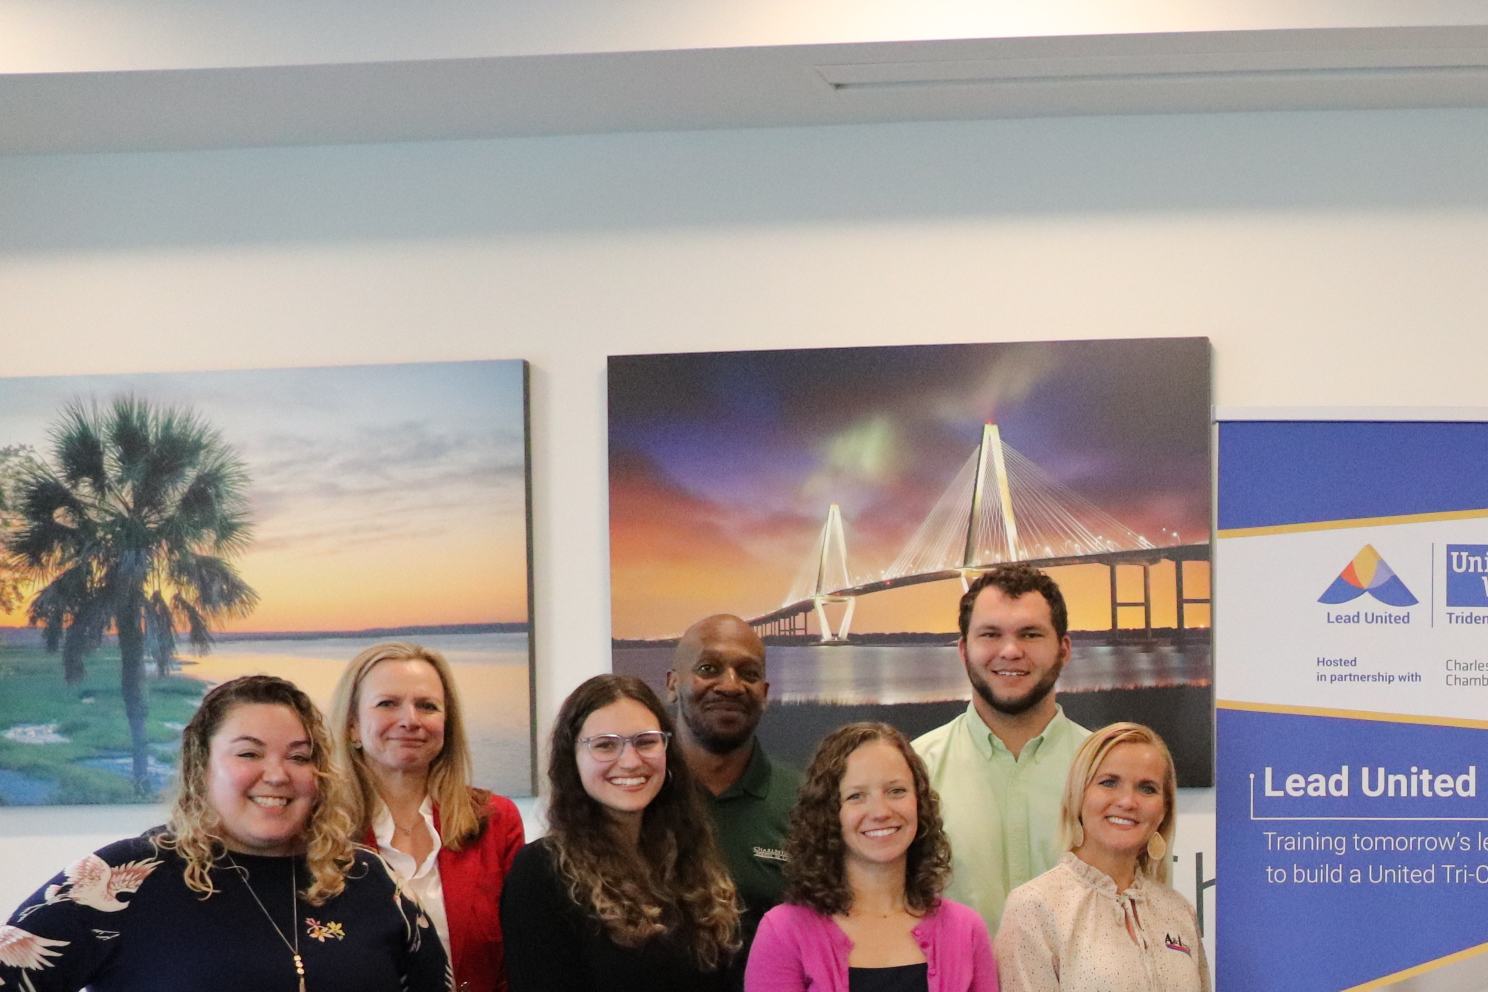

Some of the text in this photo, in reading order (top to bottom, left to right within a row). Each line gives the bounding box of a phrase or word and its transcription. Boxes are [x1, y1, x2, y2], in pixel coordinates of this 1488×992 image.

[1327, 612, 1411, 625] Lead United
[1317, 657, 1357, 667] Hosted
[1317, 672, 1421, 684] in partnership with
[1265, 765, 1476, 797] Lead United
[1263, 832, 1346, 855] Training
[1353, 832, 1470, 851] tomorrow’s
[1266, 866, 1286, 883] to
[1294, 864, 1342, 883] build
[1350, 869, 1361, 883] a
[1369, 864, 1435, 883] United
